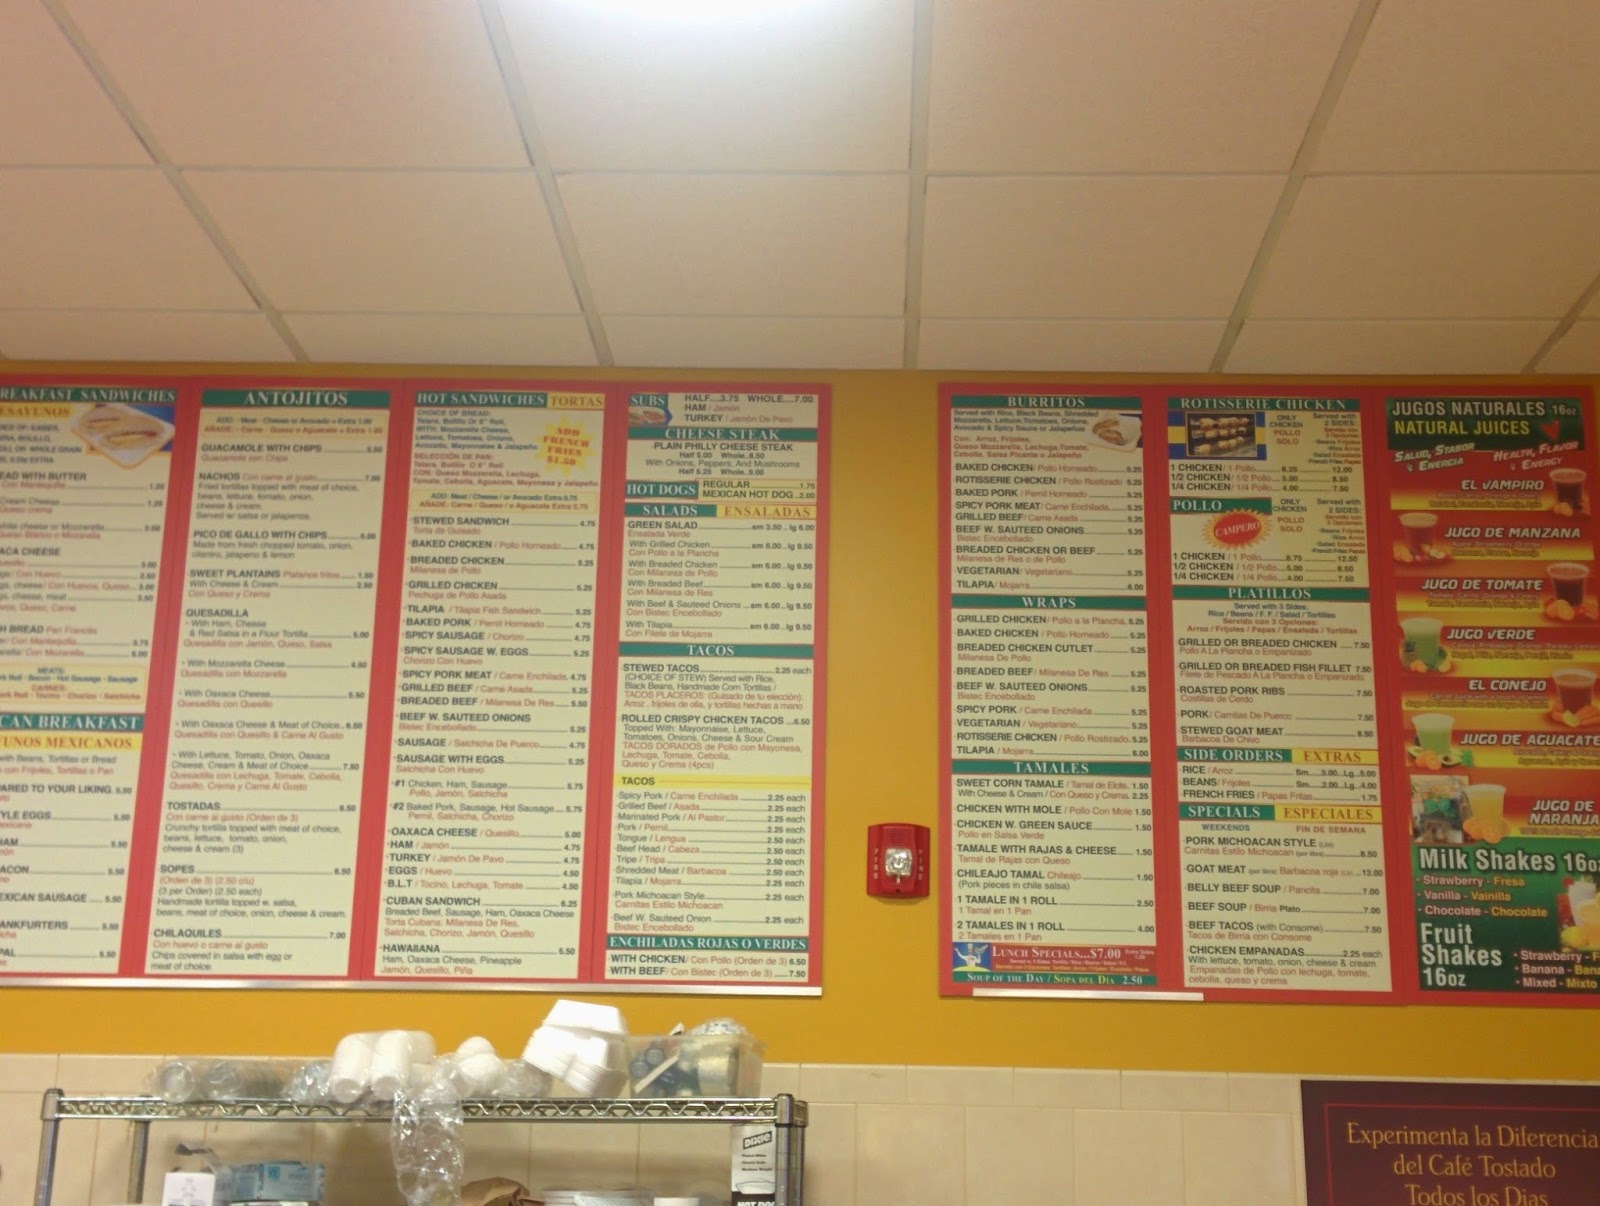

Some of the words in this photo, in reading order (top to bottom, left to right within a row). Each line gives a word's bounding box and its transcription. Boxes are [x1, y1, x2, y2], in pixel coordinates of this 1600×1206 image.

[81, 389, 175, 402] SANDWICHES
[243, 392, 348, 406] ANTOJITOS
[417, 393, 445, 405] HOT
[451, 393, 544, 406] SANDWICHES
[550, 396, 604, 407] TORTAS
[631, 395, 665, 406] SUBS
[1007, 396, 1086, 408] BURRITOS
[1181, 398, 1269, 410] ROTISSERIE
[1277, 398, 1346, 410] CHICKEN
[1393, 401, 1446, 416] JUGOS
[1452, 401, 1545, 416] NATURALES
[684, 414, 723, 424] TURKEY
[1395, 421, 1468, 435] NATURAL
[1474, 421, 1530, 435] JUICES
[665, 428, 725, 440] CHEESE
[729, 429, 779, 441] STEAK
[201, 443, 264, 452] GUACAMOLE
[266, 444, 287, 452] WITH
[293, 444, 322, 453] CHIPS
[654, 442, 680, 451] PLAIN
[683, 442, 717, 452] PHILLY
[720, 443, 758, 452] CHEESE
[761, 443, 793, 452] STEAK
[956, 463, 988, 472] BAKED
[991, 463, 1033, 472] CHICKEN
[199, 472, 241, 481] NACHOS
[627, 483, 655, 496] HOT
[658, 484, 696, 497] DOGS
[702, 480, 750, 490] REGULAR
[1461, 480, 1477, 490] EL
[1482, 480, 1544, 490] VAMPIRO
[643, 504, 698, 516] SALADS
[724, 505, 811, 518] ENSALADAS
[1173, 499, 1222, 512] POLLO
[414, 517, 454, 526] STEWED
[456, 517, 510, 527] SANDWICH
[628, 520, 663, 530] GREEN
[666, 520, 698, 530] SALAD
[1215, 521, 1261, 536] CAMPERO
[1445, 528, 1479, 538] JUGO
[1485, 528, 1504, 538] DE
[1509, 528, 1580, 538] MANZANA
[412, 540, 446, 549] BAKED
[448, 540, 492, 549] CHICKEN
[190, 570, 224, 578] SWEET
[227, 570, 281, 578] PLANTAINS
[1422, 579, 1458, 590] JUGO
[1463, 579, 1481, 590] DE
[1487, 579, 1543, 590] TOMATE
[1228, 588, 1311, 599] PLATILLOS
[1022, 597, 1076, 608] WRAPS
[186, 609, 249, 618] QUESADILLA
[1447, 629, 1483, 640] JUGO
[1487, 629, 1535, 640] VERDE
[687, 645, 734, 656] TACOS
[623, 664, 662, 673] STEWED
[667, 664, 699, 673] TACOS
[1469, 680, 1485, 691] EL
[1490, 680, 1546, 691] CONEJO
[39, 715, 140, 729] BREAKFAST
[44, 737, 132, 749] MEXICANOS
[1461, 734, 1497, 745] JUGO
[1502, 734, 1521, 745] DE
[1527, 734, 1600, 746] AGUACATE
[1184, 749, 1217, 760] SIDE
[1222, 750, 1283, 762] ORDERS
[1304, 751, 1361, 763] EXTRAS
[1014, 762, 1089, 774] TAMALES
[622, 777, 655, 785] TACOS
[957, 779, 991, 787] SWEET
[994, 779, 1022, 788] CORN
[1024, 779, 1064, 788] TAMALE
[1183, 790, 1224, 798] FRENCH
[1226, 790, 1255, 799] FRIES
[168, 801, 220, 810] TOSTADAS
[957, 805, 1002, 813] CHICKEN
[1005, 805, 1030, 814] WITH
[1033, 805, 1061, 814] MOLE
[1533, 801, 1569, 811] JUGO
[1574, 801, 1594, 811] DE
[1188, 806, 1260, 818] SPECIALS
[1284, 807, 1373, 820] ESPECIALES
[1529, 814, 1599, 825] NARANJA
[1202, 824, 1250, 832] WEEKENDS
[391, 841, 413, 849] HAM
[389, 854, 430, 862] TURKEY
[1420, 849, 1467, 870] Milk
[1476, 849, 1555, 871] Shakes
[1563, 853, 1600, 872] 16o
[160, 865, 195, 874] SOPES
[388, 867, 417, 875] EGGS
[1423, 876, 1483, 887] Strawberry
[1493, 877, 1525, 887] Fresa
[1187, 883, 1219, 893] BELLY
[1222, 883, 1249, 893] BEEF
[1252, 884, 1281, 894] SOUP
[1362, 888, 1380, 896] 7.00
[1424, 890, 1460, 900] Vanilla
[1471, 891, 1511, 901] Vainilla
[386, 897, 422, 905] CUBAN
[425, 897, 480, 906] SANDWICH
[1425, 906, 1481, 916] Chocolate
[1491, 907, 1547, 917] Chocolate
[957, 921, 963, 930] 2
[966, 921, 1014, 930] TAMALES
[1017, 922, 1027, 930] IN
[1030, 922, 1034, 931] 1
[1038, 922, 1065, 931] ROLL
[1188, 921, 1215, 930] BEEF
[1218, 921, 1254, 931] TACOS
[154, 929, 222, 938] CHILAQUILES
[1421, 923, 1473, 944] Fruit
[610, 937, 696, 949] ENCHILADAS
[698, 938, 739, 949] ROJAS
[741, 938, 751, 949] O
[753, 939, 806, 950] VERDES
[1189, 946, 1236, 955] CHICKEN
[1239, 946, 1304, 956] EMPANADAS
[1422, 944, 1502, 966] Shakes
[611, 954, 636, 963] WITH
[638, 954, 685, 964] CHICKEN
[1520, 951, 1582, 963] Strawberry
[1522, 965, 1564, 975] Banana
[1523, 978, 1556, 988] Mixed
[1566, 978, 1597, 988] Mixto
[1347, 1122, 1468, 1148] Experimenta
[1475, 1125, 1491, 1146] la
[1497, 1125, 1599, 1148] Diferencia
[1393, 1154, 1423, 1175] del
[1428, 1155, 1473, 1176] Café
[1478, 1155, 1556, 1178] Tostado
[1405, 1184, 1465, 1206] Todos
[1471, 1186, 1498, 1206] los
[1505, 1187, 1548, 1206] Dias
